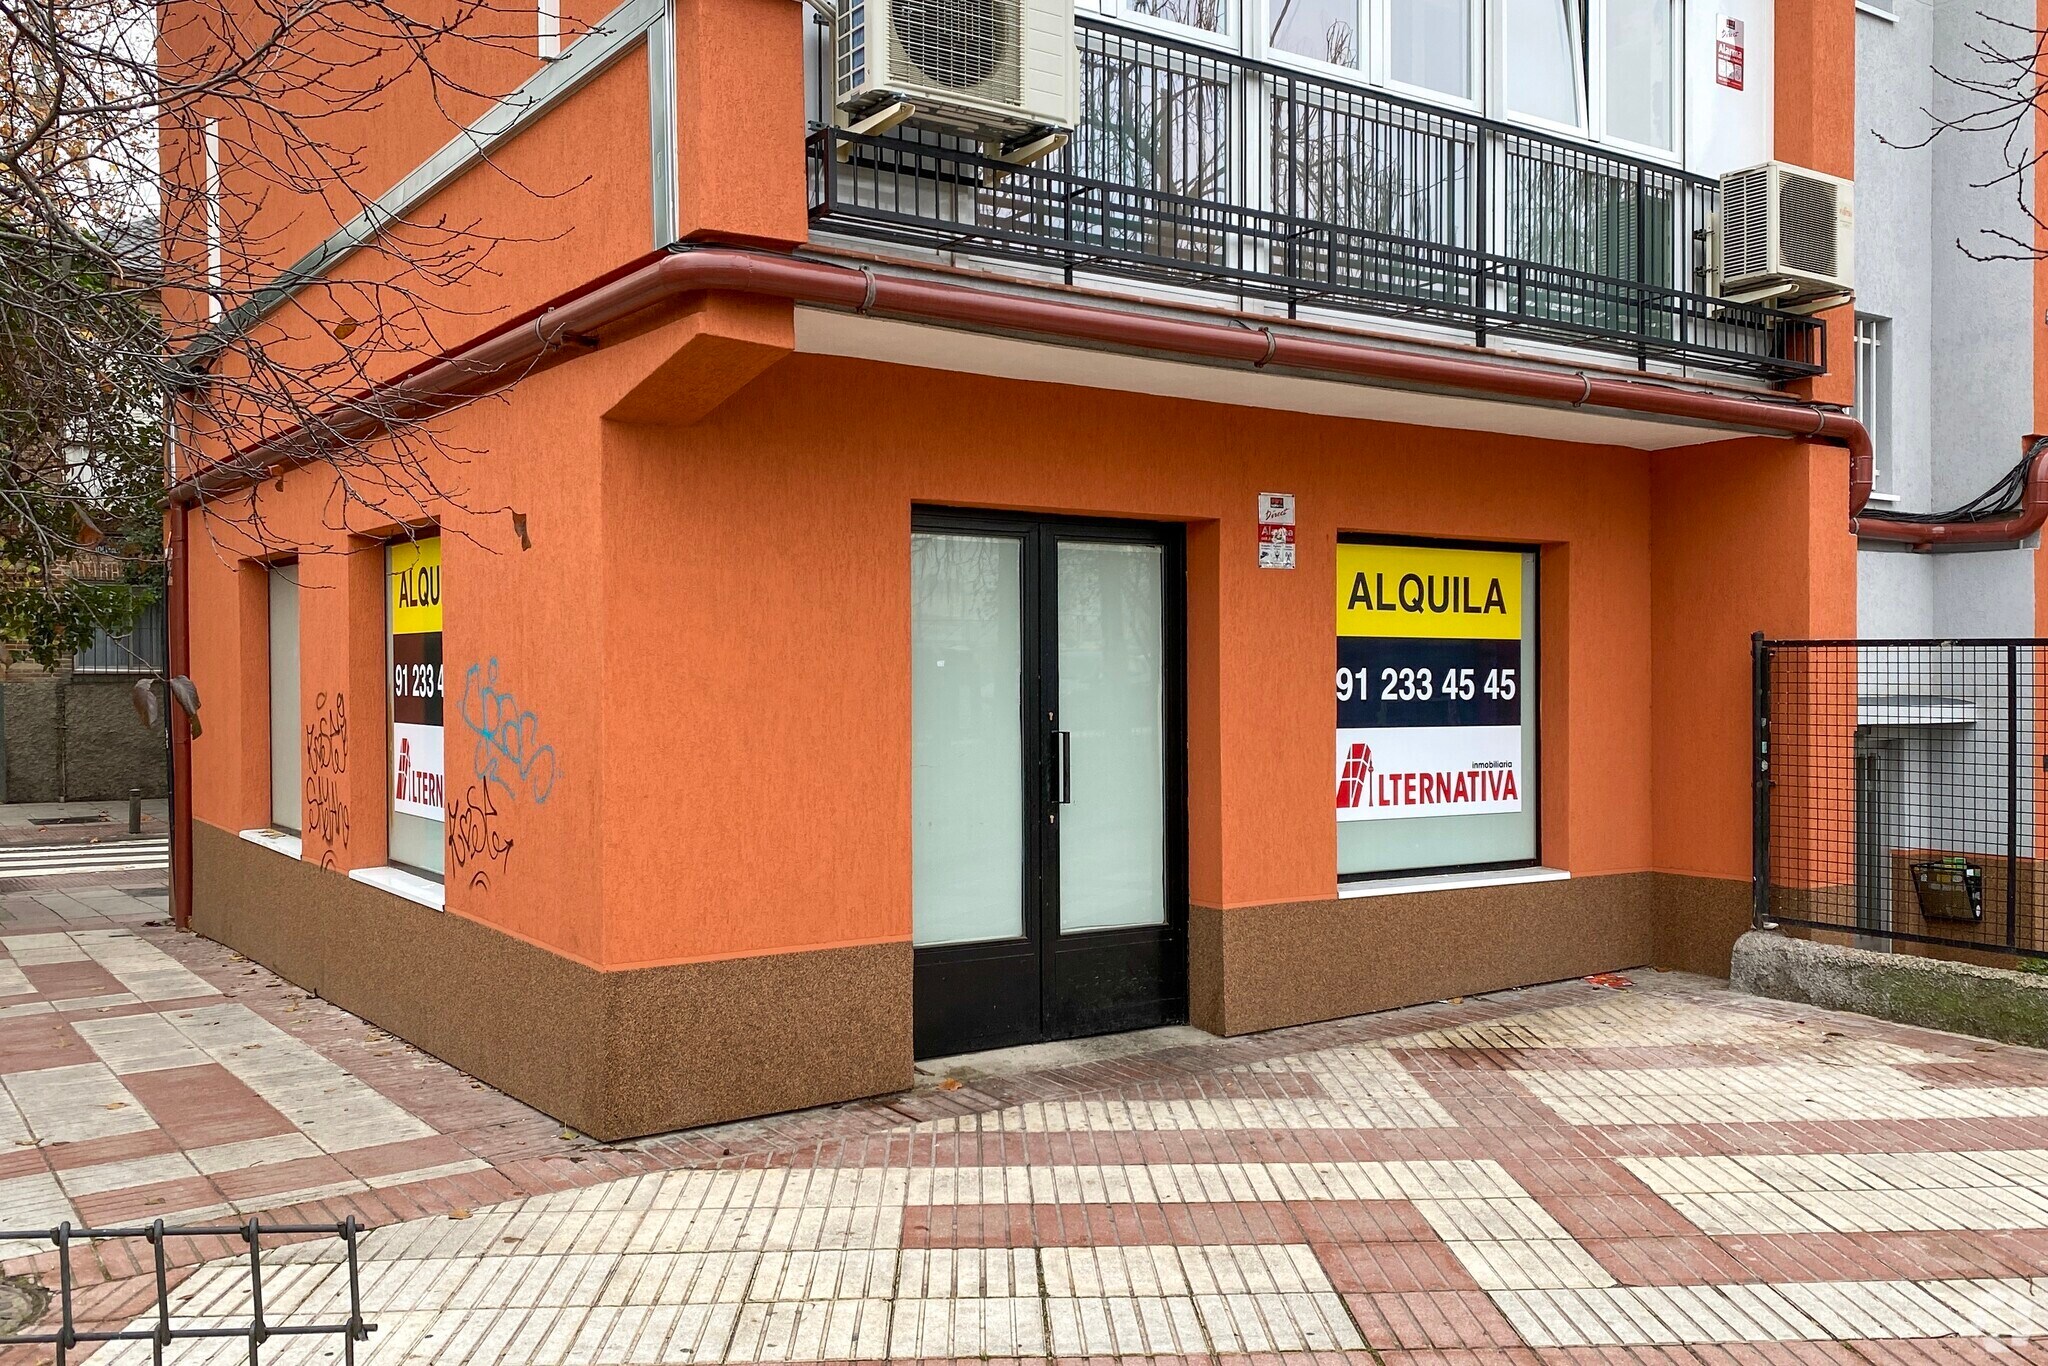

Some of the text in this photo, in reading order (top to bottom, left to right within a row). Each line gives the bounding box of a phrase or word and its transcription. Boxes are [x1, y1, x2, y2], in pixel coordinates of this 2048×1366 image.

[399, 565, 440, 608] ALQU
[1347, 572, 1507, 614] ALQUILA
[395, 664, 408, 697] 91
[412, 663, 434, 698] 233
[1336, 667, 1516, 701] 91 233 45 45
[1472, 761, 1513, 769] inmobiliaria
